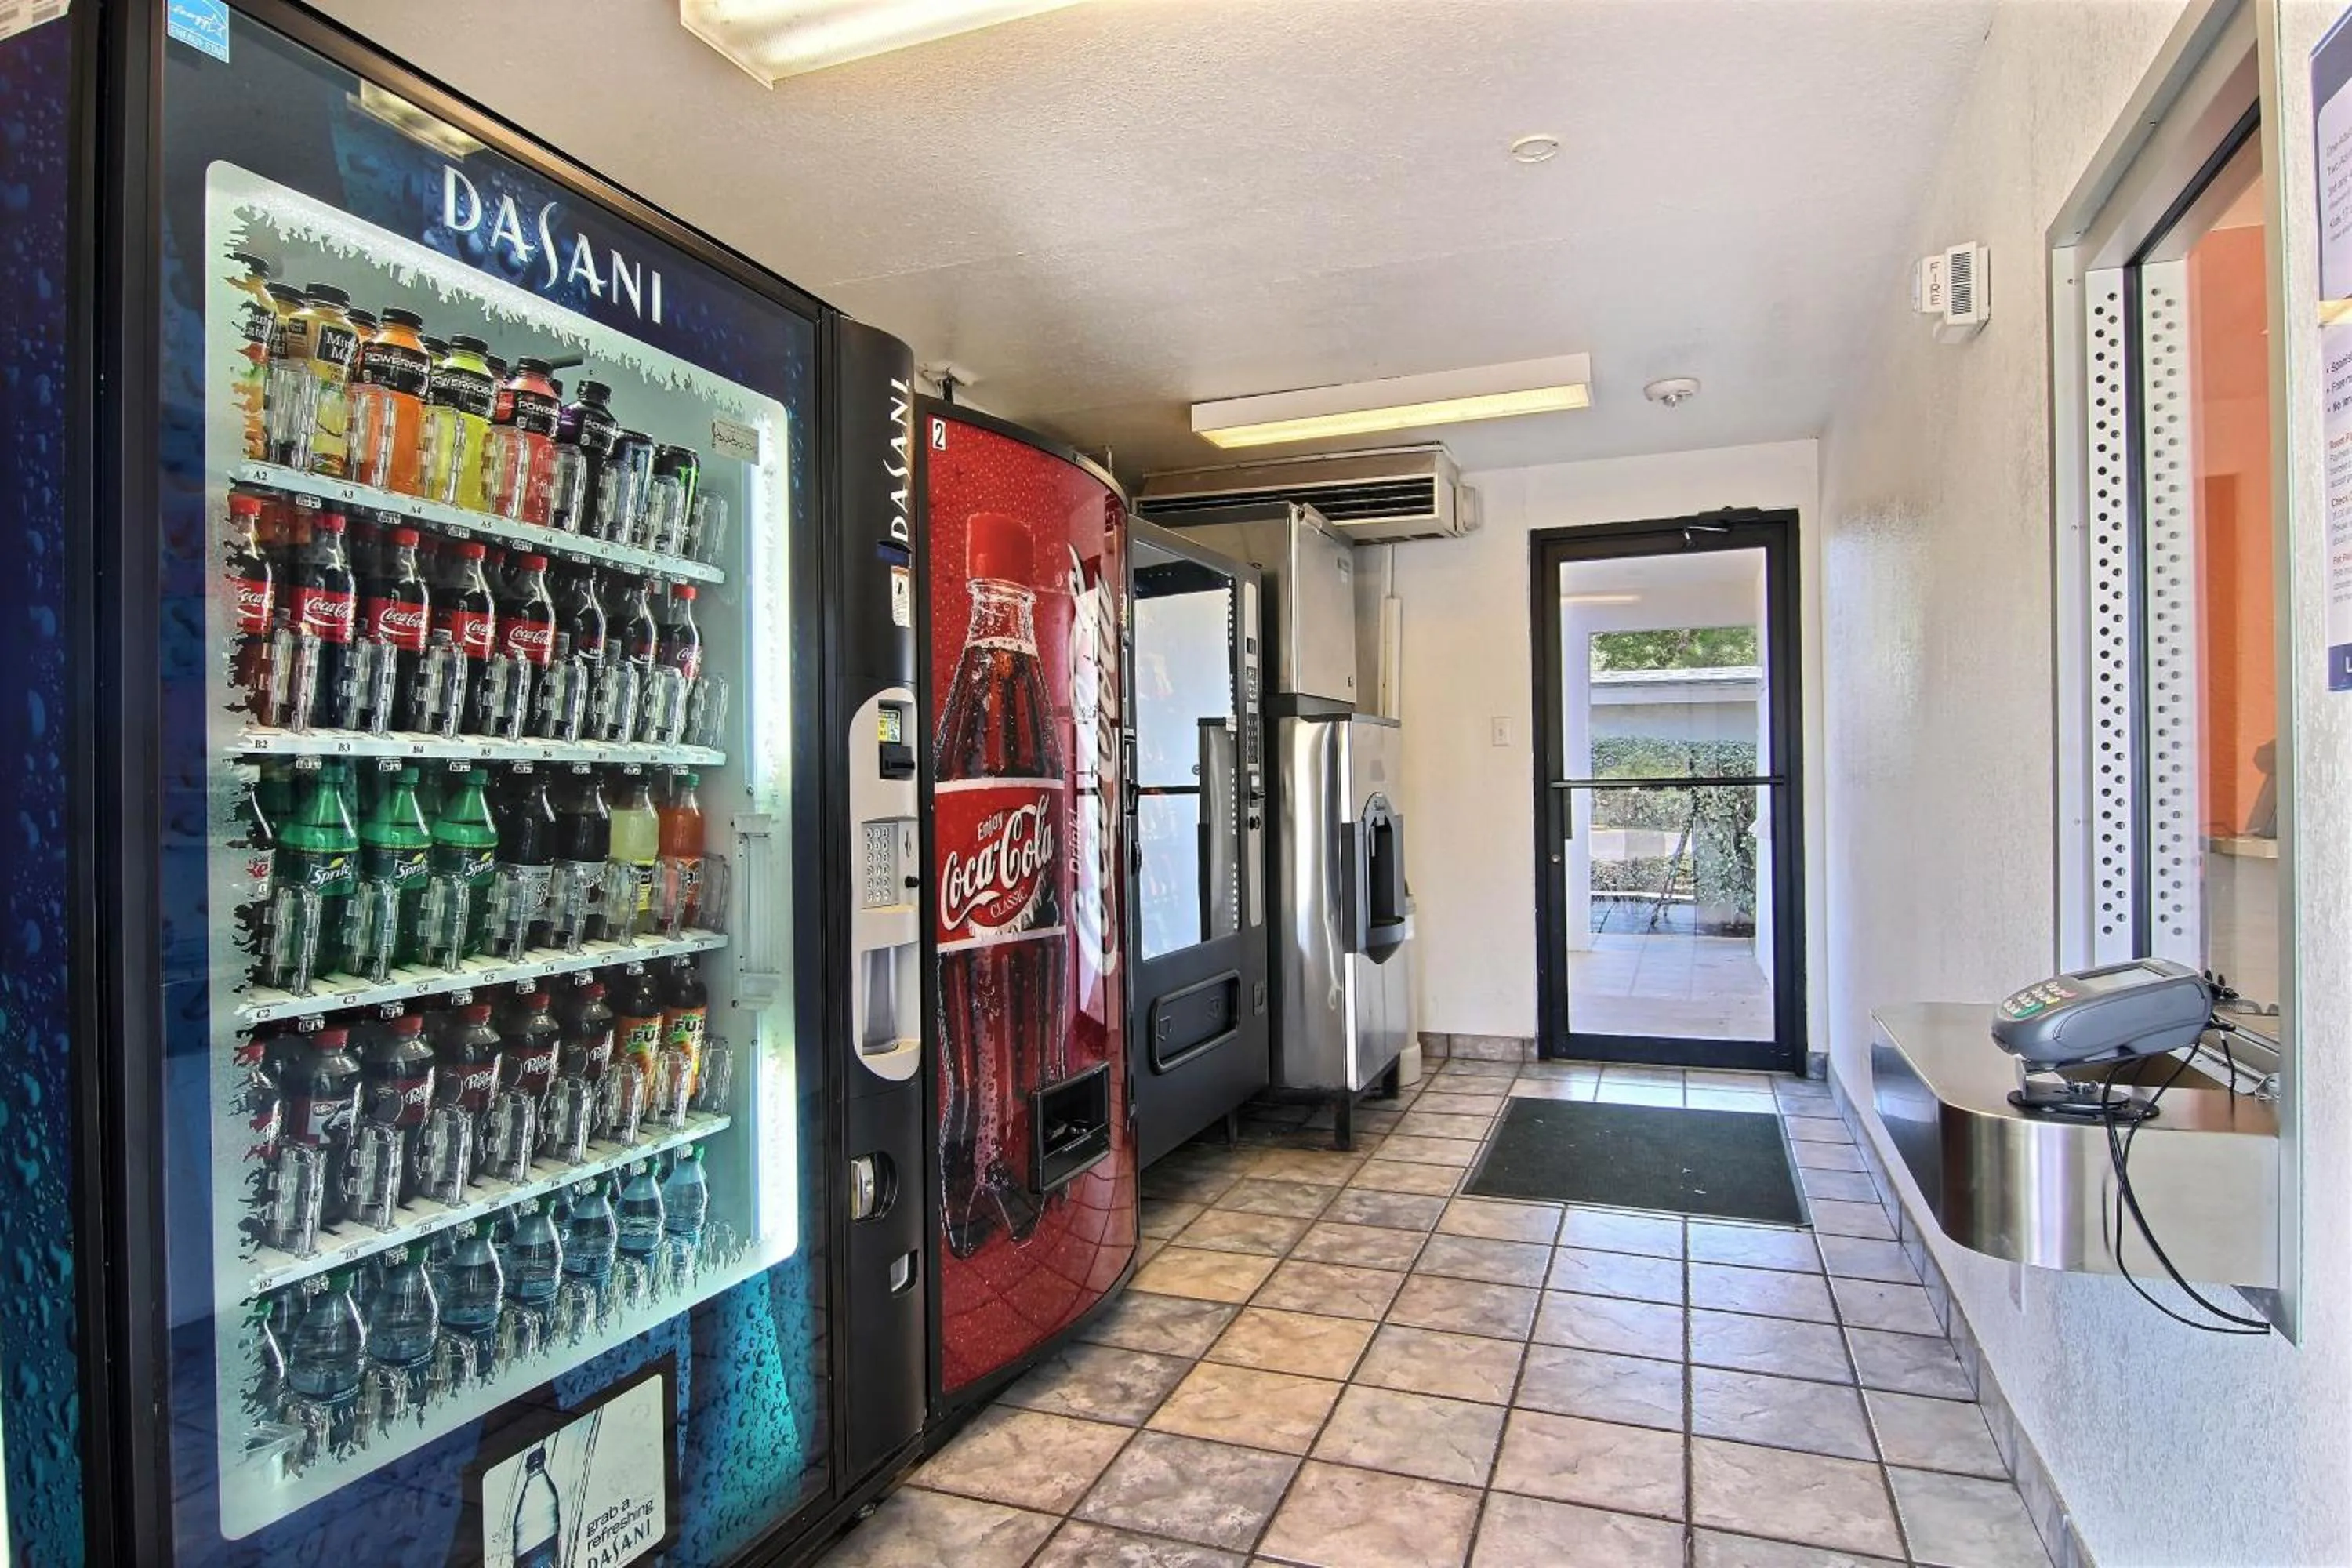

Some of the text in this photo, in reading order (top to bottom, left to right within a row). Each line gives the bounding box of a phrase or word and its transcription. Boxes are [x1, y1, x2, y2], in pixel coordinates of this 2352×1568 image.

[443, 164, 662, 325] DASANI
[1930, 261, 1941, 306] FIRE
[935, 423, 943, 448] 2
[883, 377, 912, 543] DASANI
[253, 472, 267, 481] A2
[341, 489, 354, 499] A3
[254, 739, 267, 749] B2
[338, 742, 350, 752] B3
[978, 810, 1004, 842] Enjoy
[941, 793, 1054, 931] Coca-Cola
[989, 886, 1029, 919] CLASSIC
[586, 1498, 630, 1537] grab a
[586, 1499, 655, 1552] refreshing
[587, 1519, 652, 1568] DASANI
